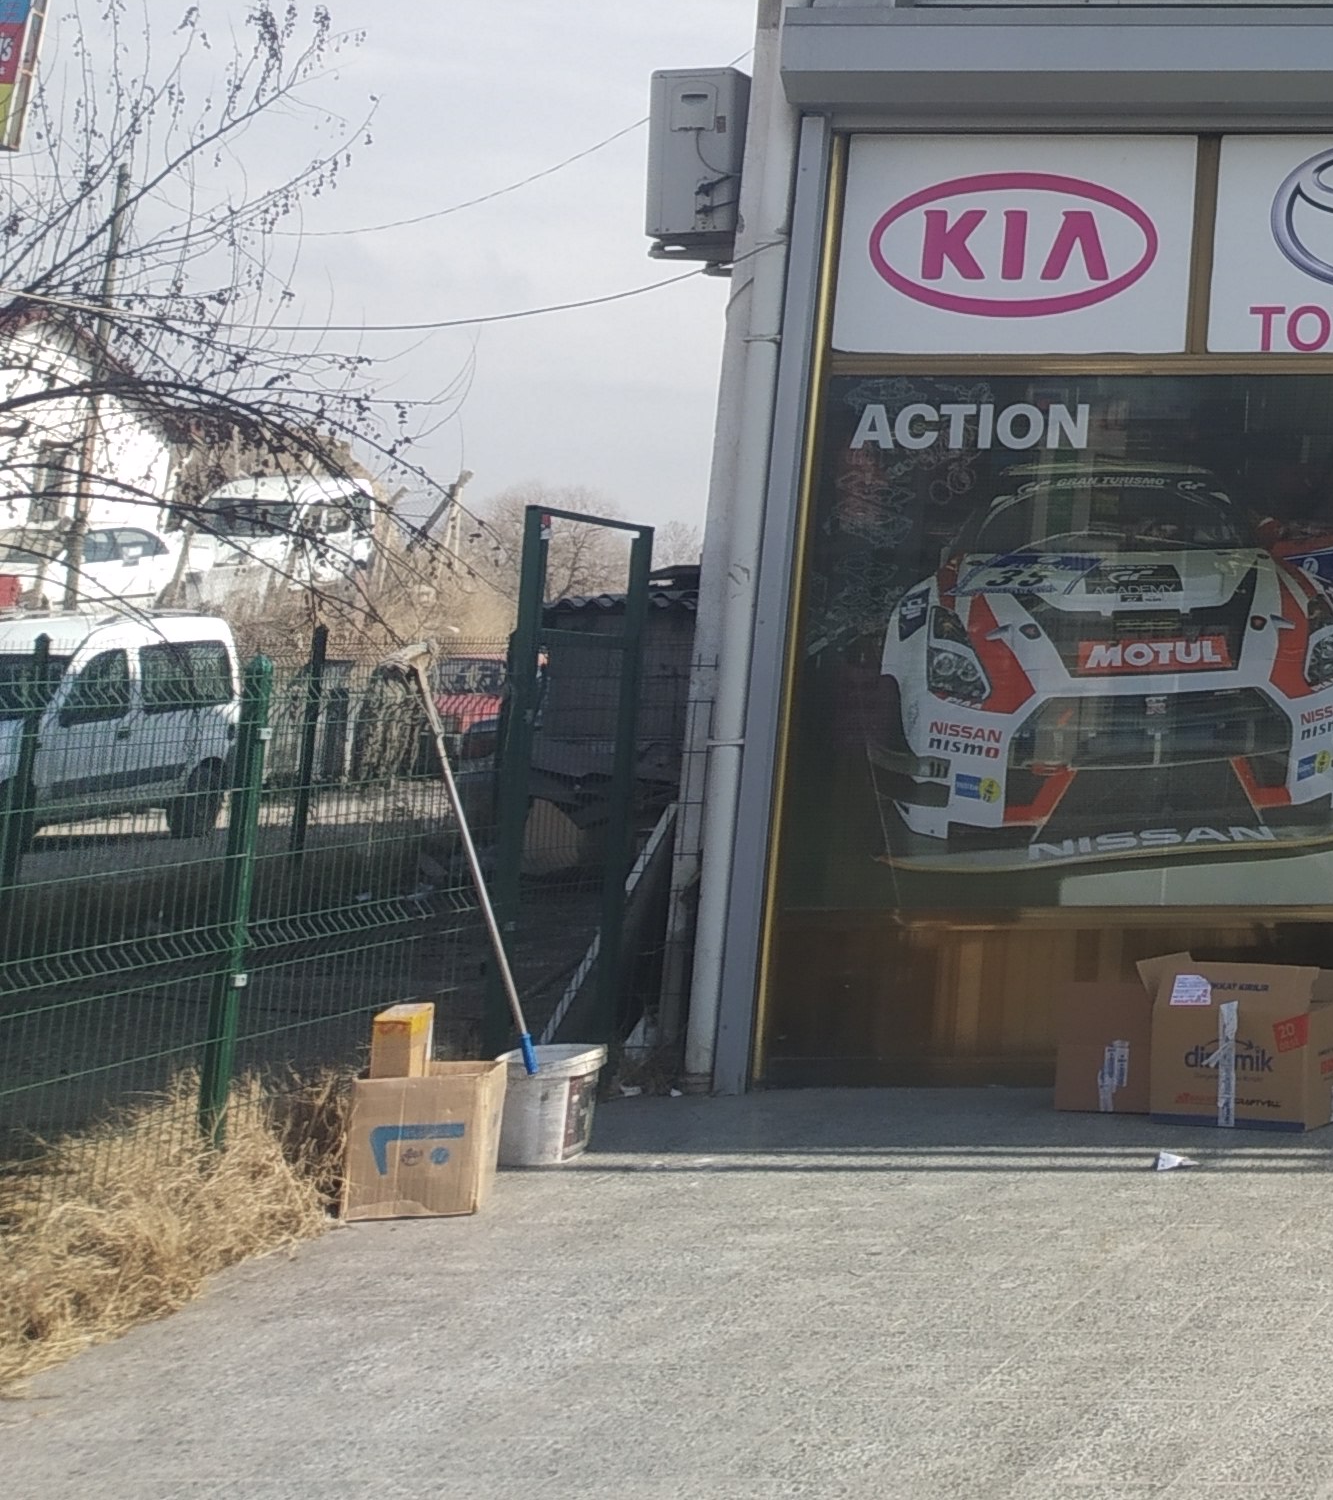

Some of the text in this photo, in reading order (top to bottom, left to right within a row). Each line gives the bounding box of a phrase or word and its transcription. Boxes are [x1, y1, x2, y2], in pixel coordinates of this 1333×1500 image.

[921, 209, 1108, 281] KIA
[850, 403, 1091, 451] ACTION
[1056, 477, 1097, 486] GRAN
[1094, 585, 1177, 595] ACADEMY
[1085, 641, 1222, 669] MOTUL
[929, 721, 1003, 743] NISSAN
[1028, 825, 1278, 860] NISSAN
